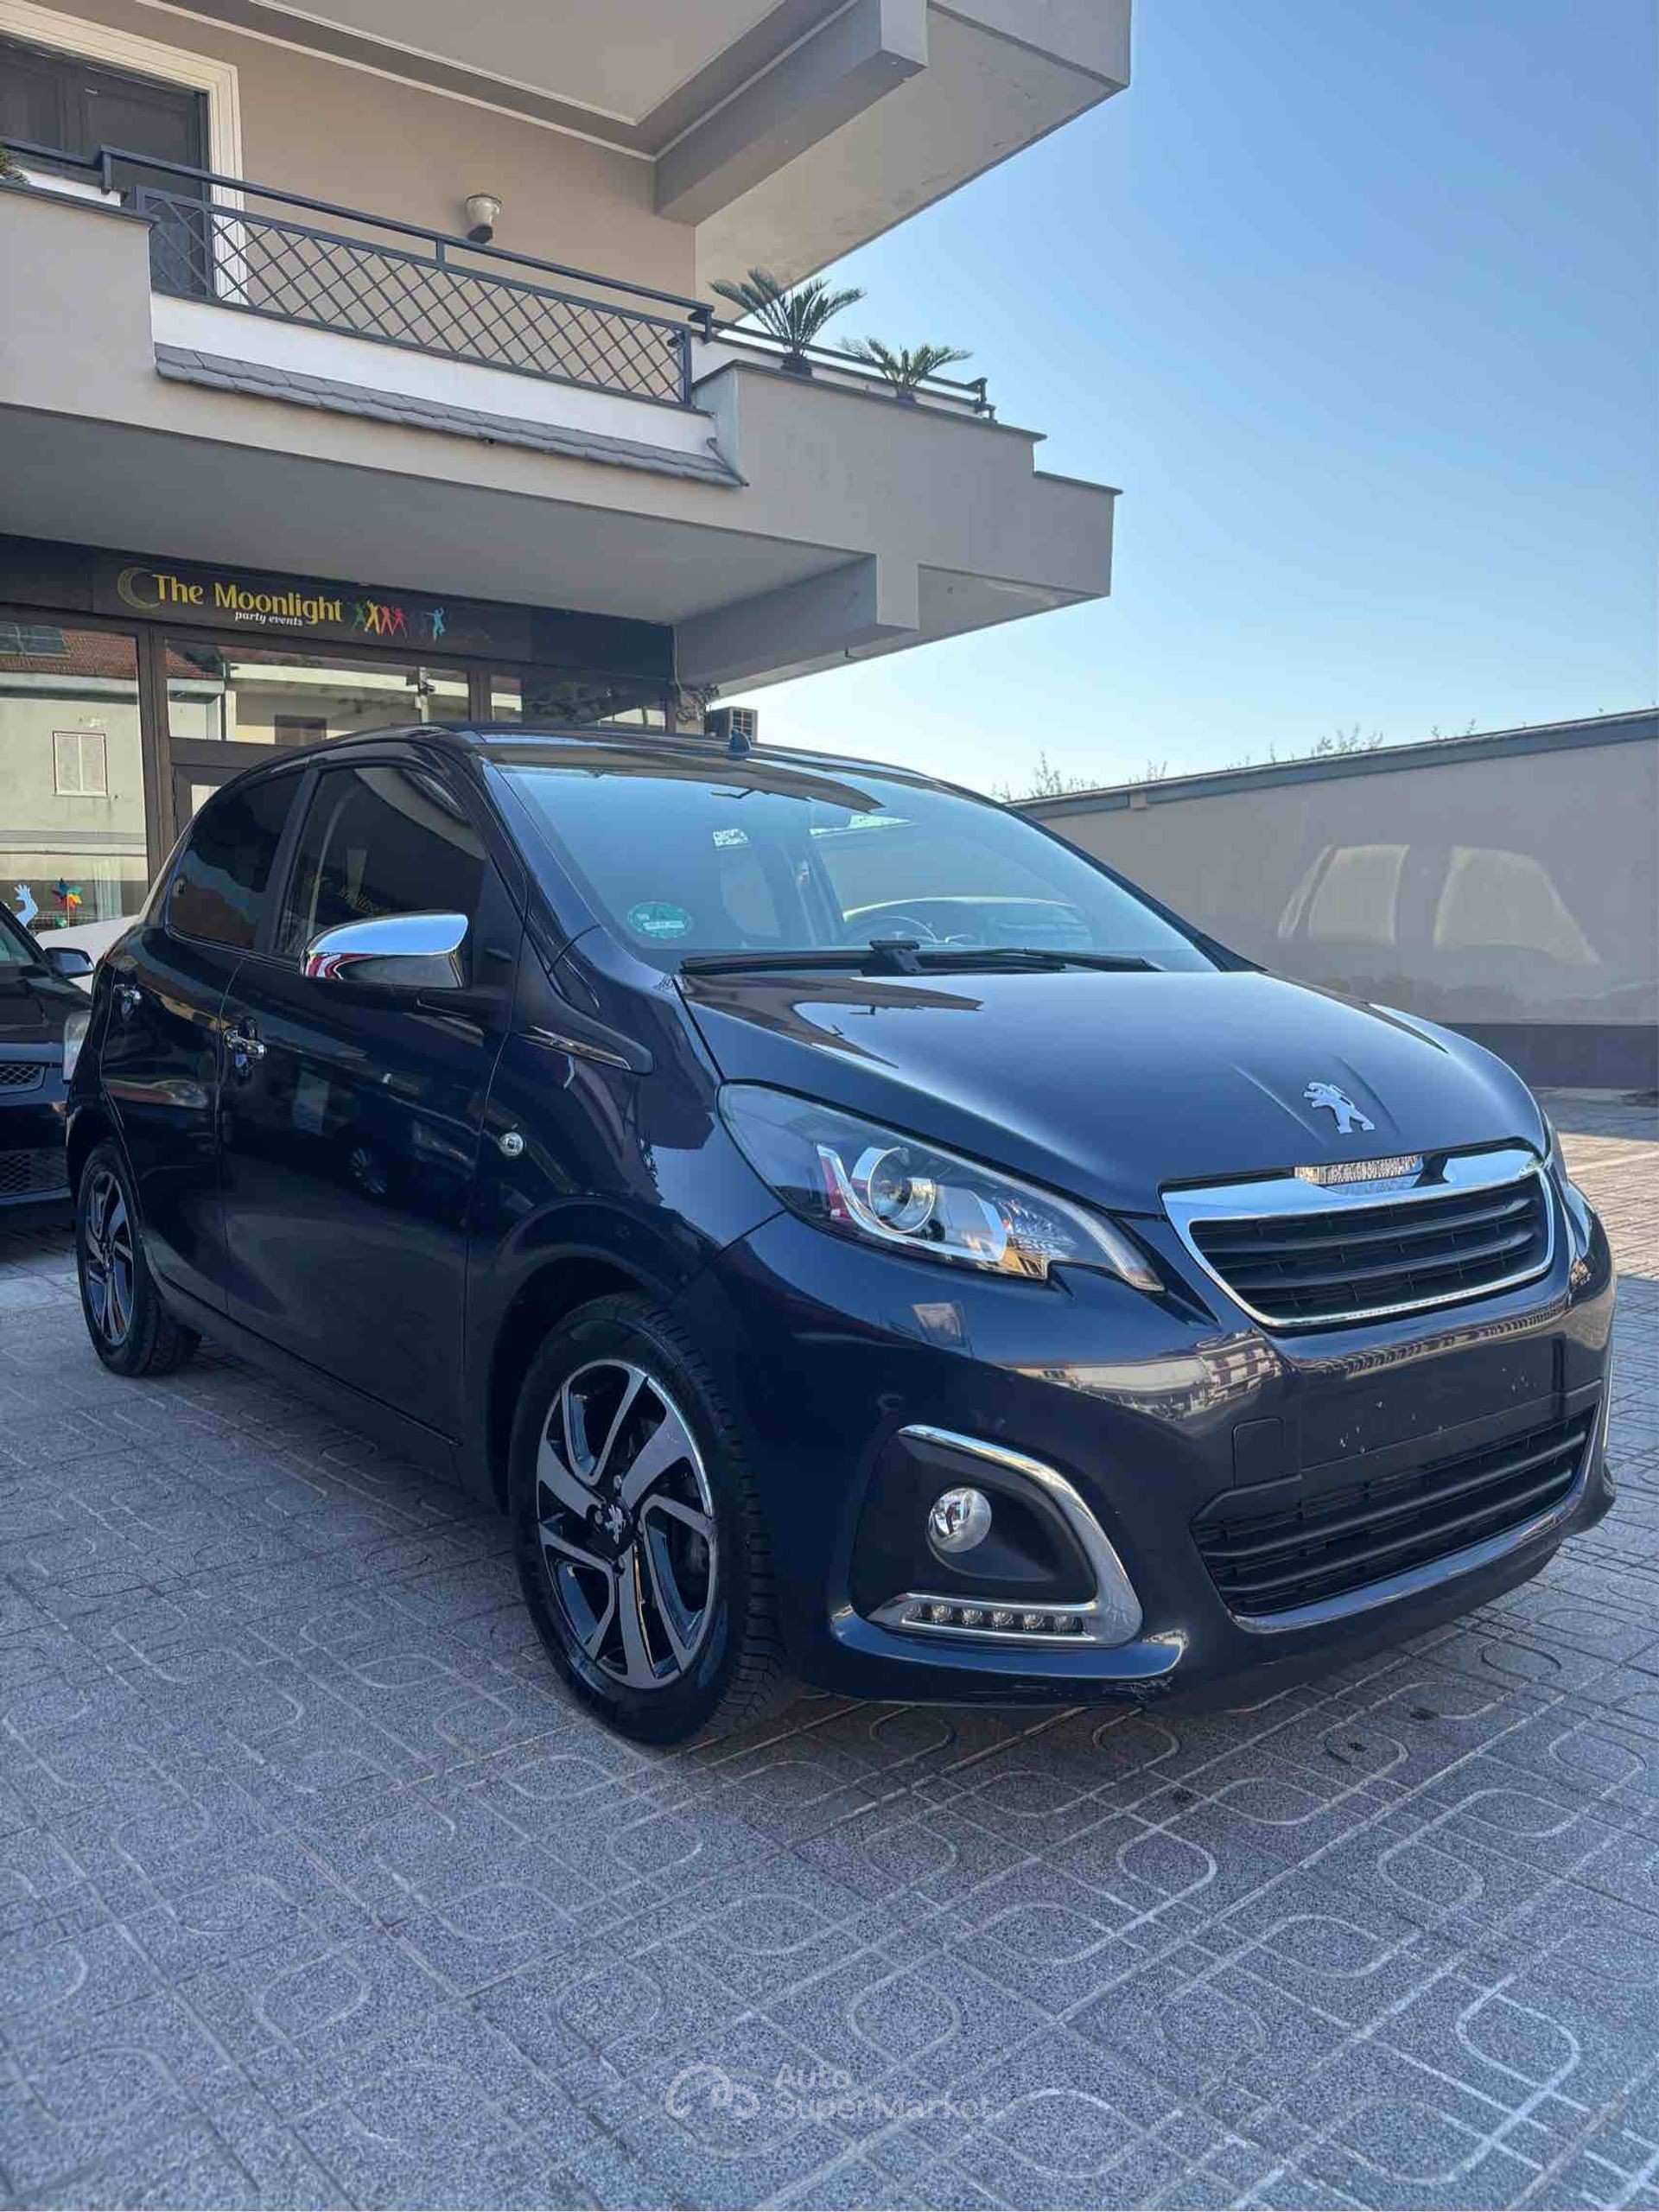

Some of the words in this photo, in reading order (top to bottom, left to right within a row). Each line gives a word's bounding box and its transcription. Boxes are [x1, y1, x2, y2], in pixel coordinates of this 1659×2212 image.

[151, 574, 204, 605] The
[213, 582, 343, 625] Moonlight
[234, 611, 266, 625] party
[269, 615, 303, 626] events
